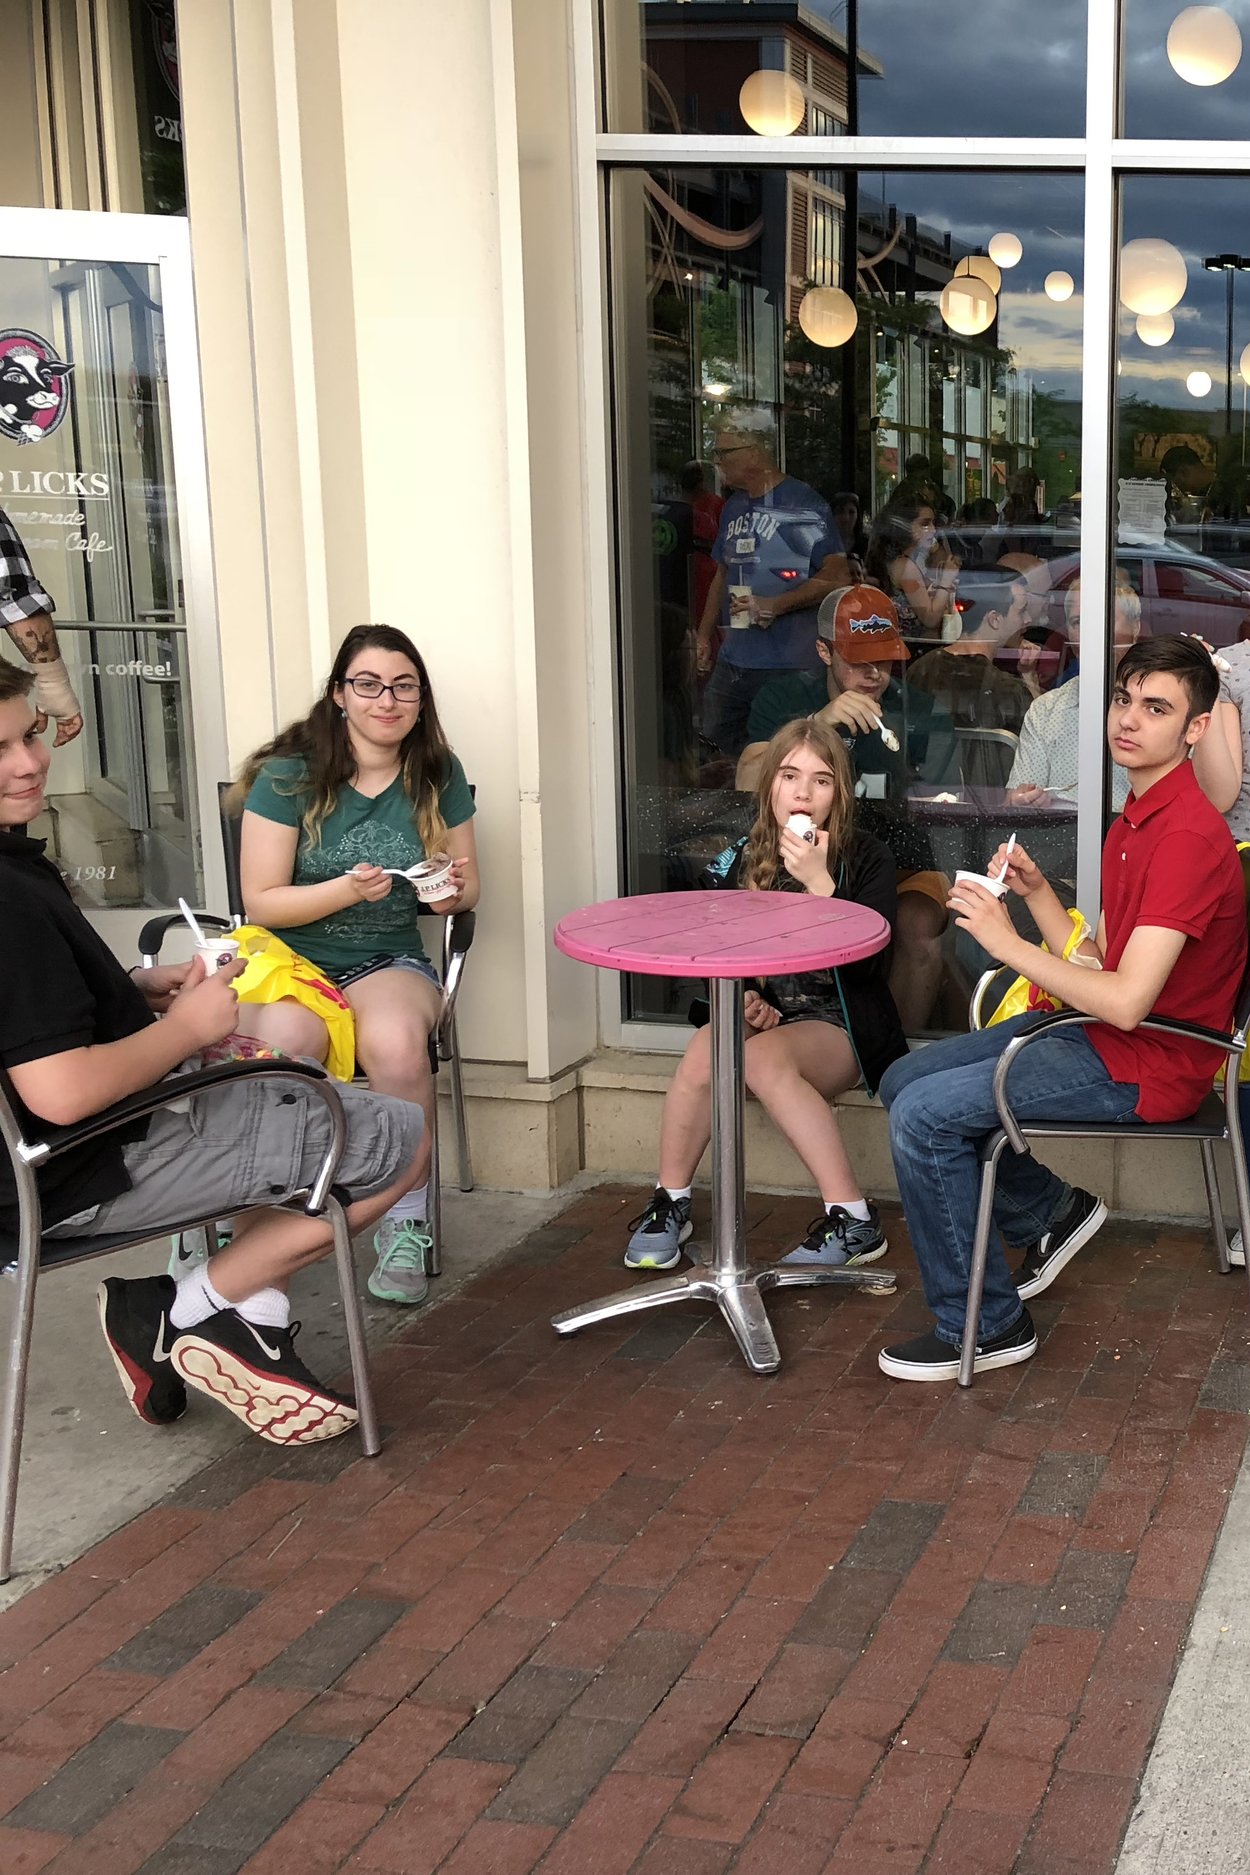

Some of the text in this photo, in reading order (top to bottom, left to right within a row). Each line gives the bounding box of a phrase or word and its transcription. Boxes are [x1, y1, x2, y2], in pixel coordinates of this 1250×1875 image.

[9, 470, 109, 496] LICKS
[726, 512, 780, 540] BOSTON
[66, 532, 113, 562] Cafe
[105, 660, 171, 676] coffee!
[74, 865, 116, 880] 1981
